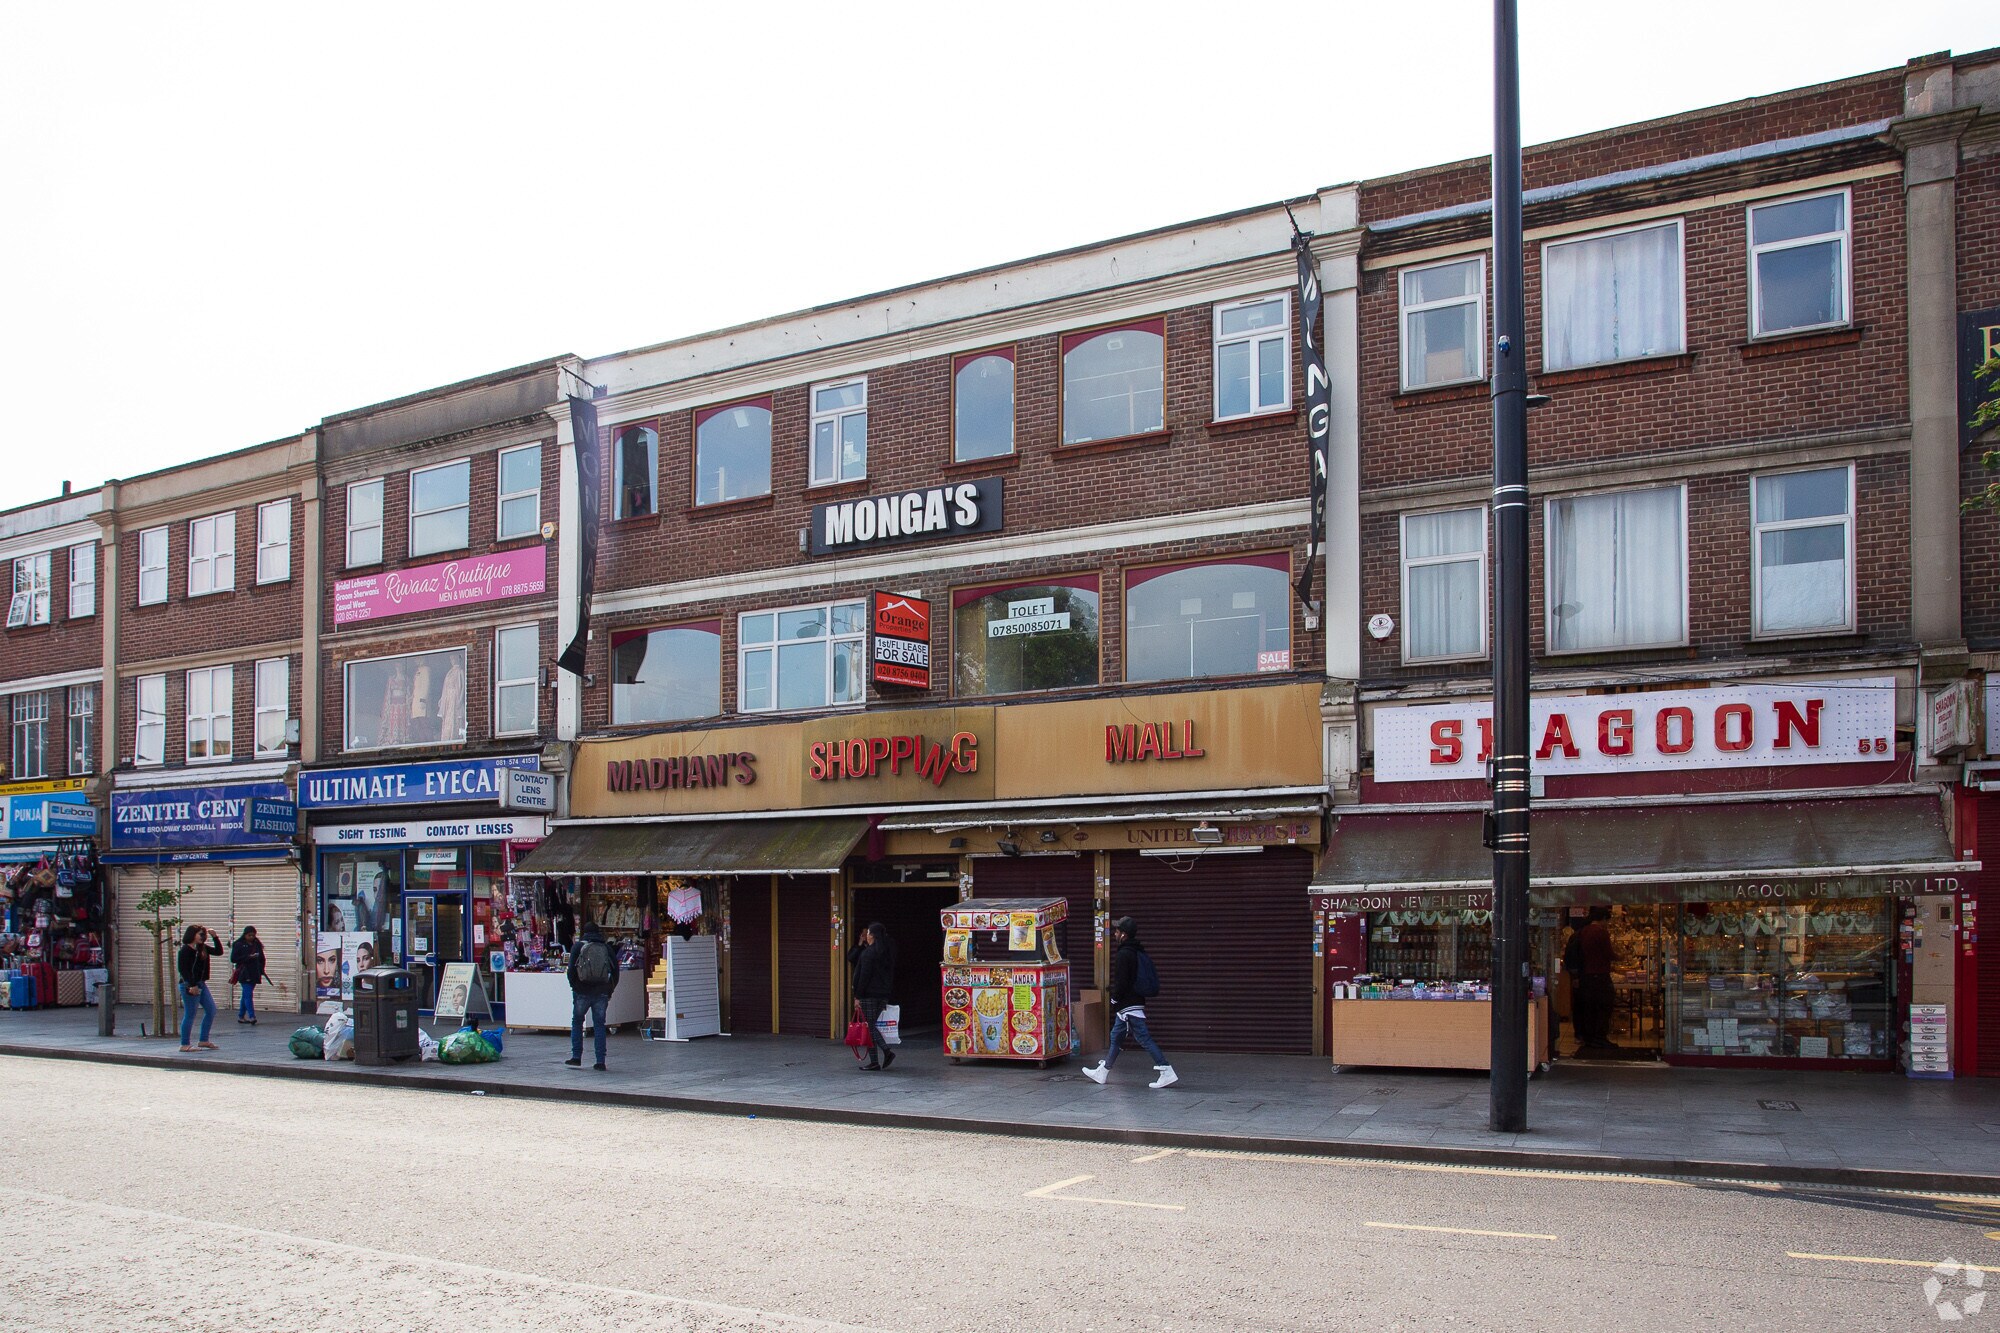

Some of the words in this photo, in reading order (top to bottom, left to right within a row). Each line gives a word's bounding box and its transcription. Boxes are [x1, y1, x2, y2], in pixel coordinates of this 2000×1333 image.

[826, 484, 978, 546] MONGA'S
[336, 580, 350, 592] Bridal
[351, 578, 377, 591] Lehengas
[442, 562, 512, 595] Boutique
[336, 592, 353, 602] Groom
[353, 588, 379, 598] Sherwanis
[438, 592, 453, 603] MEN
[454, 591, 458, 601] &
[459, 586, 483, 600] WOMEN
[501, 586, 512, 597] 078
[513, 584, 528, 595] 8875
[529, 580, 544, 593] 5659
[336, 602, 352, 612] Casual
[352, 600, 366, 609] Wear
[336, 612, 345, 622] 020
[345, 610, 358, 620] 8574
[358, 608, 371, 618] 2257
[880, 610, 925, 632] Orange
[992, 620, 1062, 636] 07850085071
[878, 638, 901, 650] 1st/FL
[902, 641, 926, 654] LEASE
[876, 647, 898, 662] FOR
[902, 652, 928, 666] SALE
[1260, 652, 1288, 664] SALE
[878, 666, 891, 676] 020
[1105, 719, 1205, 763] MALL
[1858, 737, 1888, 754] 55
[809, 732, 978, 787] SHOPPING
[514, 773, 549, 785] CONTACT
[607, 751, 757, 793] MADHAN'S
[310, 774, 407, 802] ULTIMATE
[426, 766, 520, 796] EYECA
[522, 785, 541, 796] LENS
[516, 795, 547, 806] CENTRE
[60, 806, 94, 817] Lebara
[117, 802, 190, 823] ZENITH
[256, 802, 293, 816] ZENITH
[147, 825, 180, 833] BROADWAY
[182, 824, 216, 832] SOUTHALL
[220, 822, 244, 830] MIDDX
[254, 818, 296, 832] FASHION
[338, 828, 364, 840] SIGHT
[369, 827, 406, 839] TESTING
[426, 825, 470, 837] CONTACT
[476, 823, 514, 835] LENSES
[1127, 827, 1196, 844] UNITE
[188, 852, 210, 860] CENTRE
[1723, 882, 1799, 899] HAGOON
[1924, 878, 1965, 892] LTD.
[1321, 896, 1392, 910] SHAGOON
